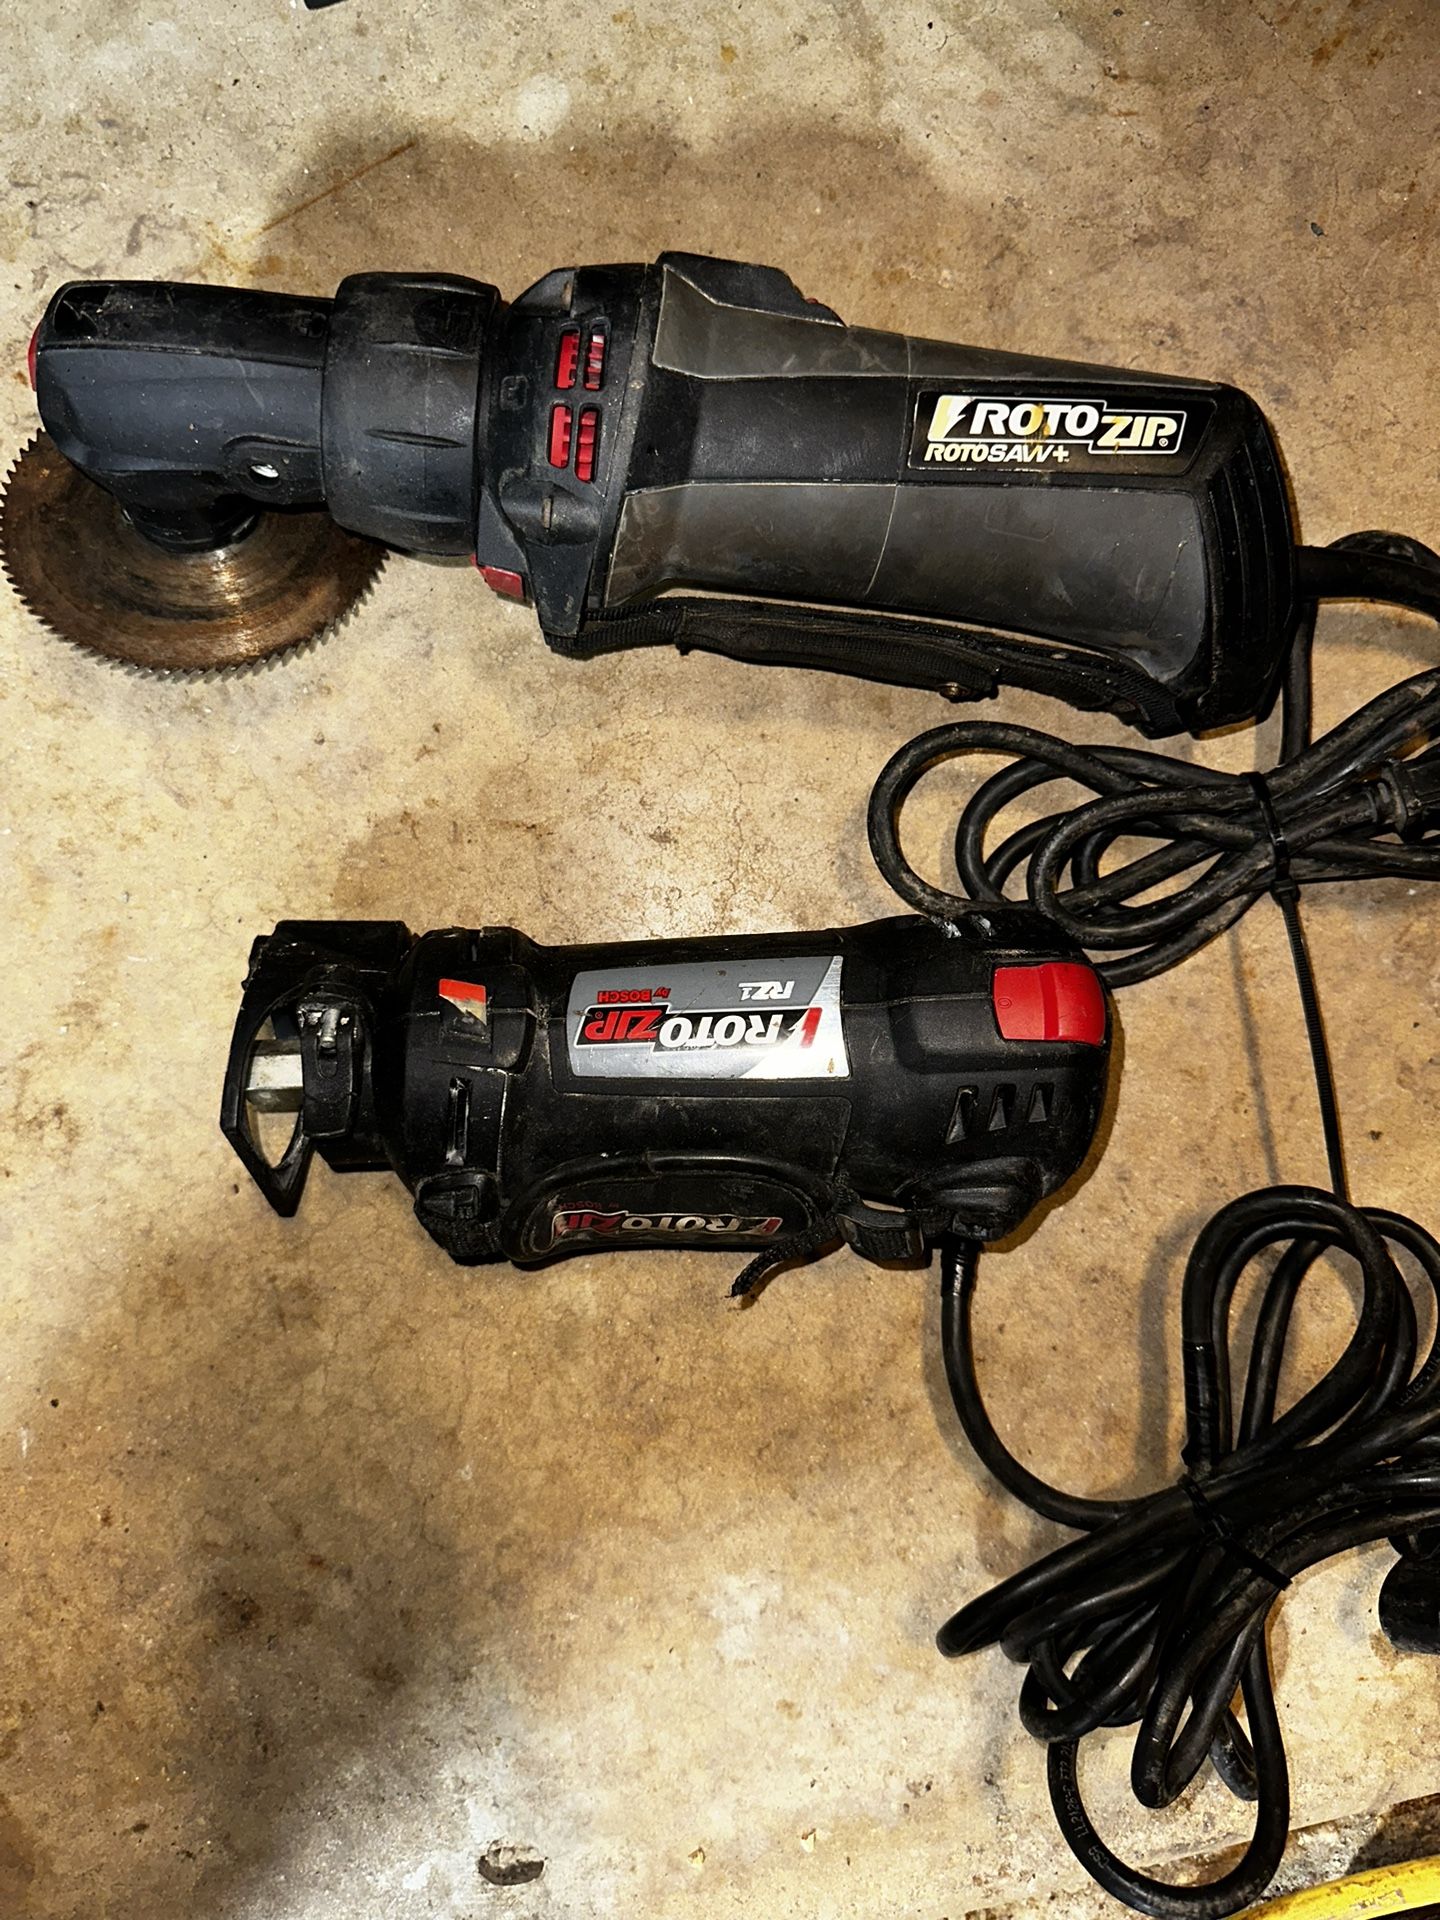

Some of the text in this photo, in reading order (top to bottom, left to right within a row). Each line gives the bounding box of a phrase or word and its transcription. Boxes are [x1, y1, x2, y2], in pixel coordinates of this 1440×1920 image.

[597, 986, 671, 1003] by BOSCH
[738, 980, 795, 1001] RZ1
